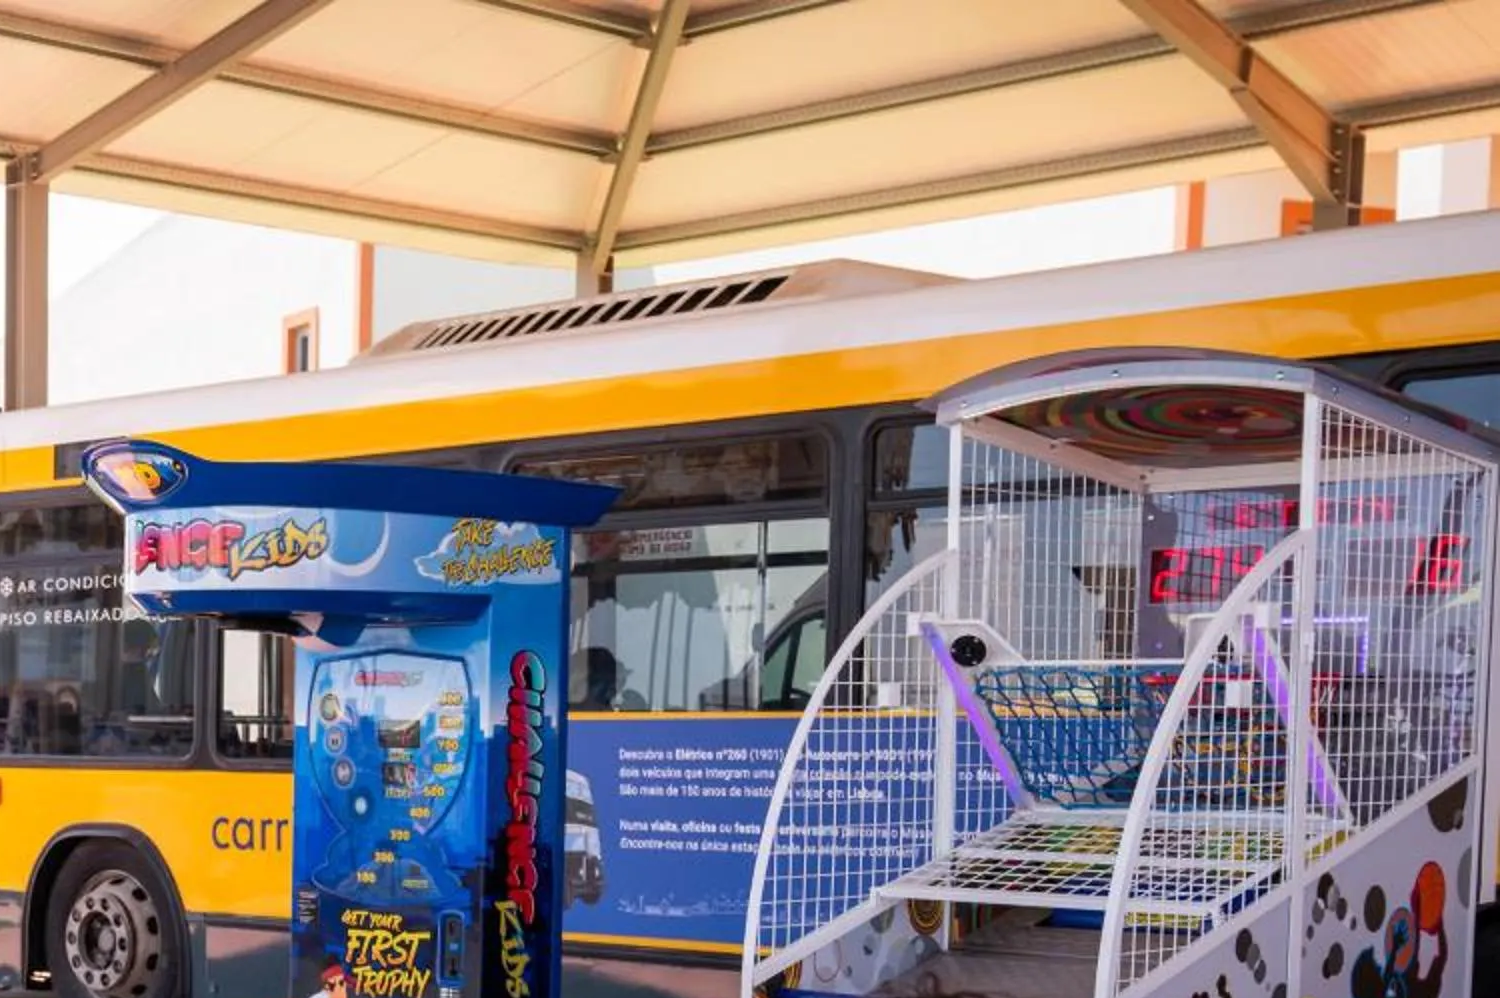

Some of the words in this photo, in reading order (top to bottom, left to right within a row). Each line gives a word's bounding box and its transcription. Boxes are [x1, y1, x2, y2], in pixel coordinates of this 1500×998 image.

[135, 518, 245, 575] ENGE
[228, 517, 330, 581] KIDS
[452, 518, 498, 554] TAKE
[464, 540, 555, 585] CHALLENGE
[17, 579, 37, 593] AR
[0, 611, 37, 626] PISO
[44, 607, 123, 625] REBAIXAD
[506, 651, 546, 925] CHALLENGE
[744, 786, 776, 798] histór
[212, 816, 289, 851] carr
[619, 819, 649, 831] Numa
[682, 820, 717, 833] oficina
[731, 842, 758, 854] estaç
[341, 908, 369, 925] GET
[369, 911, 403, 931] YOUR
[345, 929, 431, 968] FIRST
